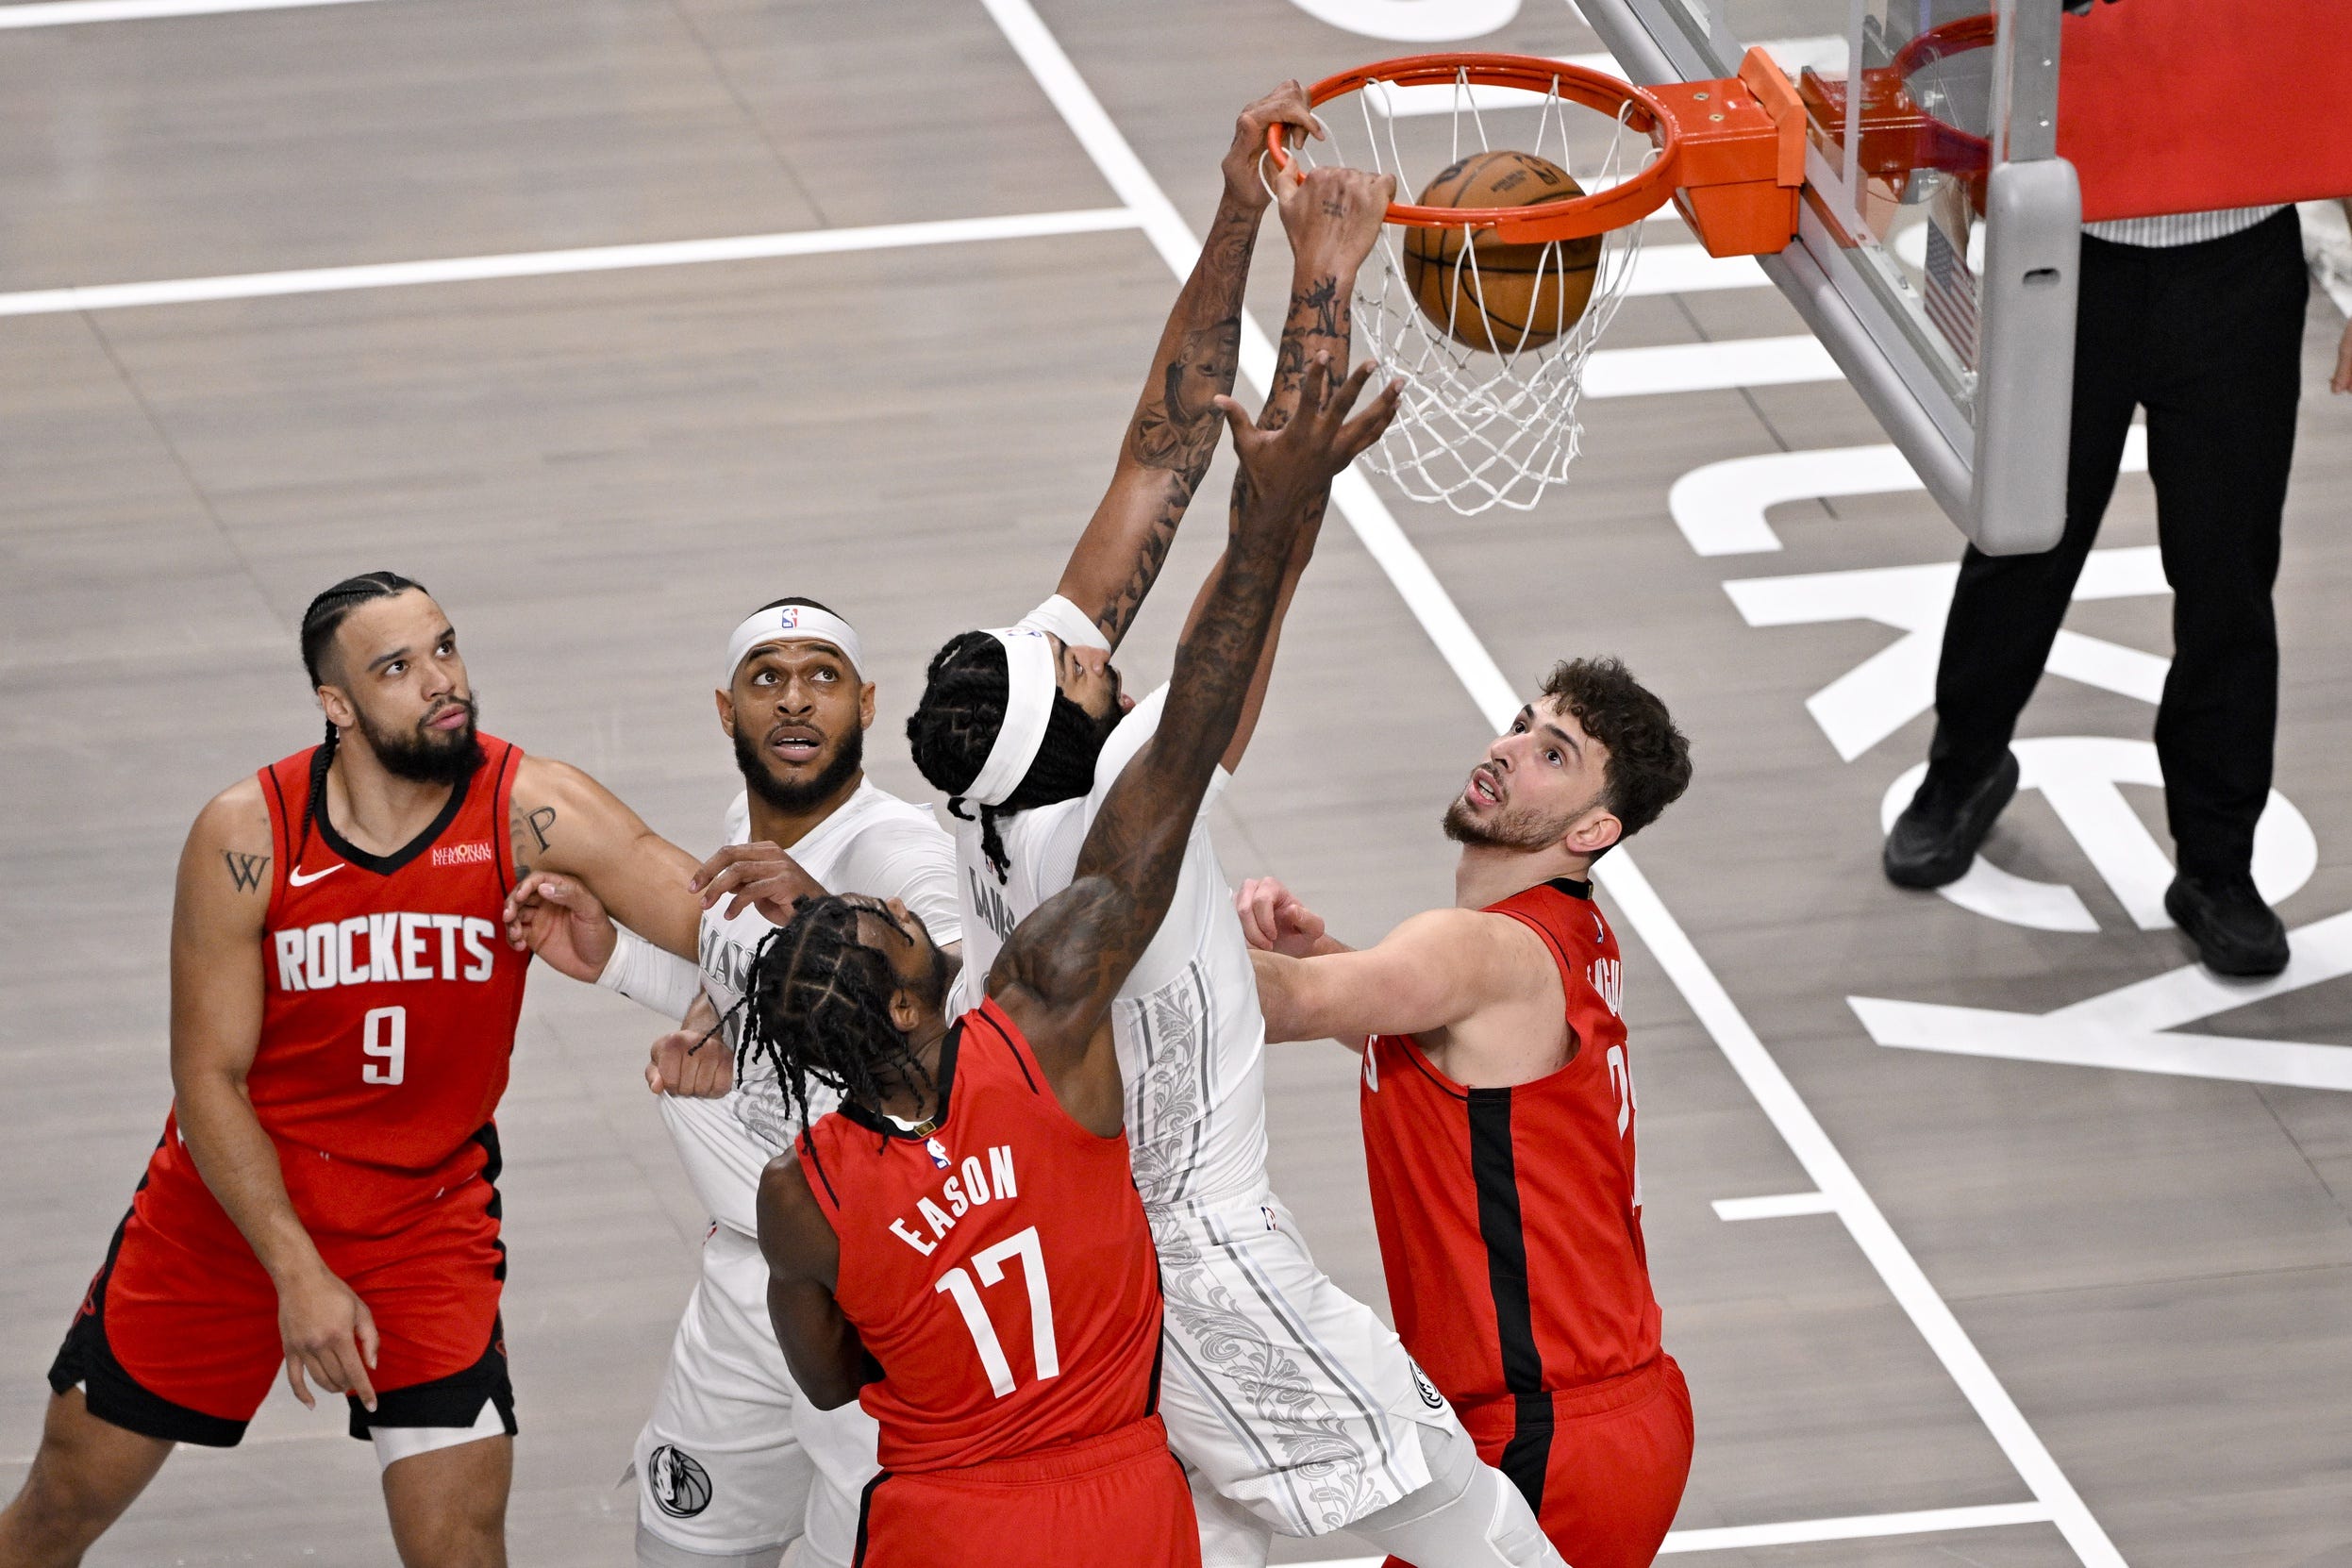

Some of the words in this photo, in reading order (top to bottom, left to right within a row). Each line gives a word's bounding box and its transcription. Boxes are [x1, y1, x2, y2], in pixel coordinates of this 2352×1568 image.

[432, 842, 492, 858] MEMORIAL
[432, 850, 492, 866] HERMANN
[523, 806, 556, 855] P
[223, 849, 271, 894] W
[275, 911, 496, 992] ROCKETS
[362, 1005, 407, 1086] 9
[888, 1144, 1018, 1258] EASON
[934, 1225, 1059, 1399] 17
